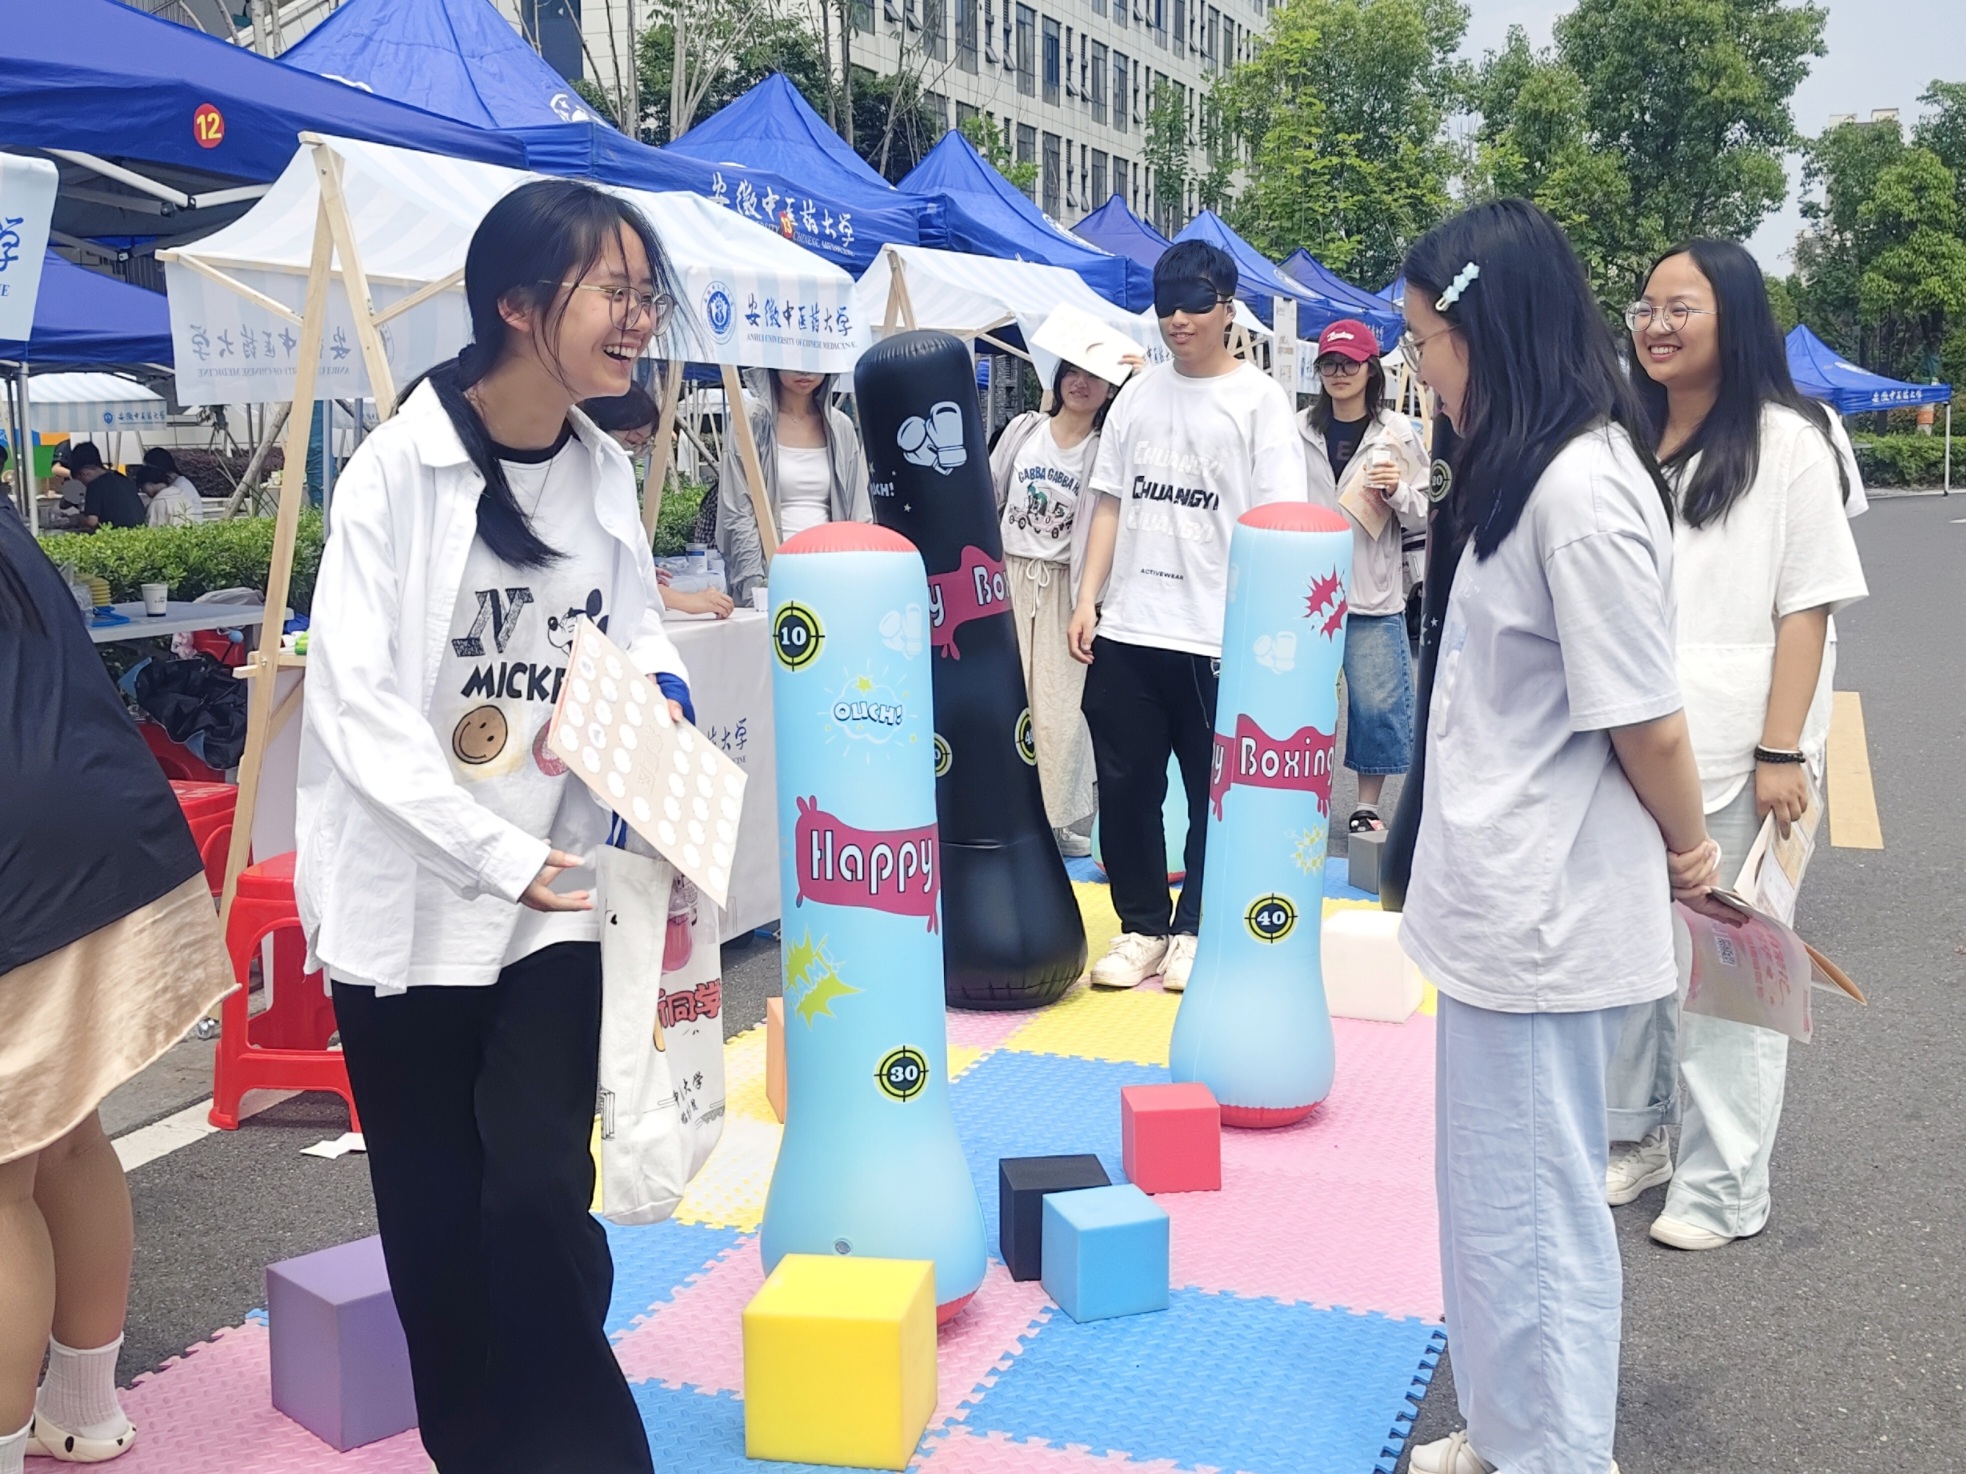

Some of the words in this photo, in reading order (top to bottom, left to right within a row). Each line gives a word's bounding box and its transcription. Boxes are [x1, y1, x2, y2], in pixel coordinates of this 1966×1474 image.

[196, 112, 223, 141] 12
[745, 293, 853, 337] 安徽中医药大学
[1018, 466, 1046, 483] GABBA
[1047, 468, 1075, 492] GABBA
[1140, 568, 1184, 581] ACTIVEWEAR
[780, 626, 807, 646] 10
[833, 702, 904, 726] OUCH!
[1241, 735, 1334, 787] Boxing
[810, 829, 934, 895] Happy
[1256, 910, 1286, 926] 40
[890, 1064, 918, 1082] 30
